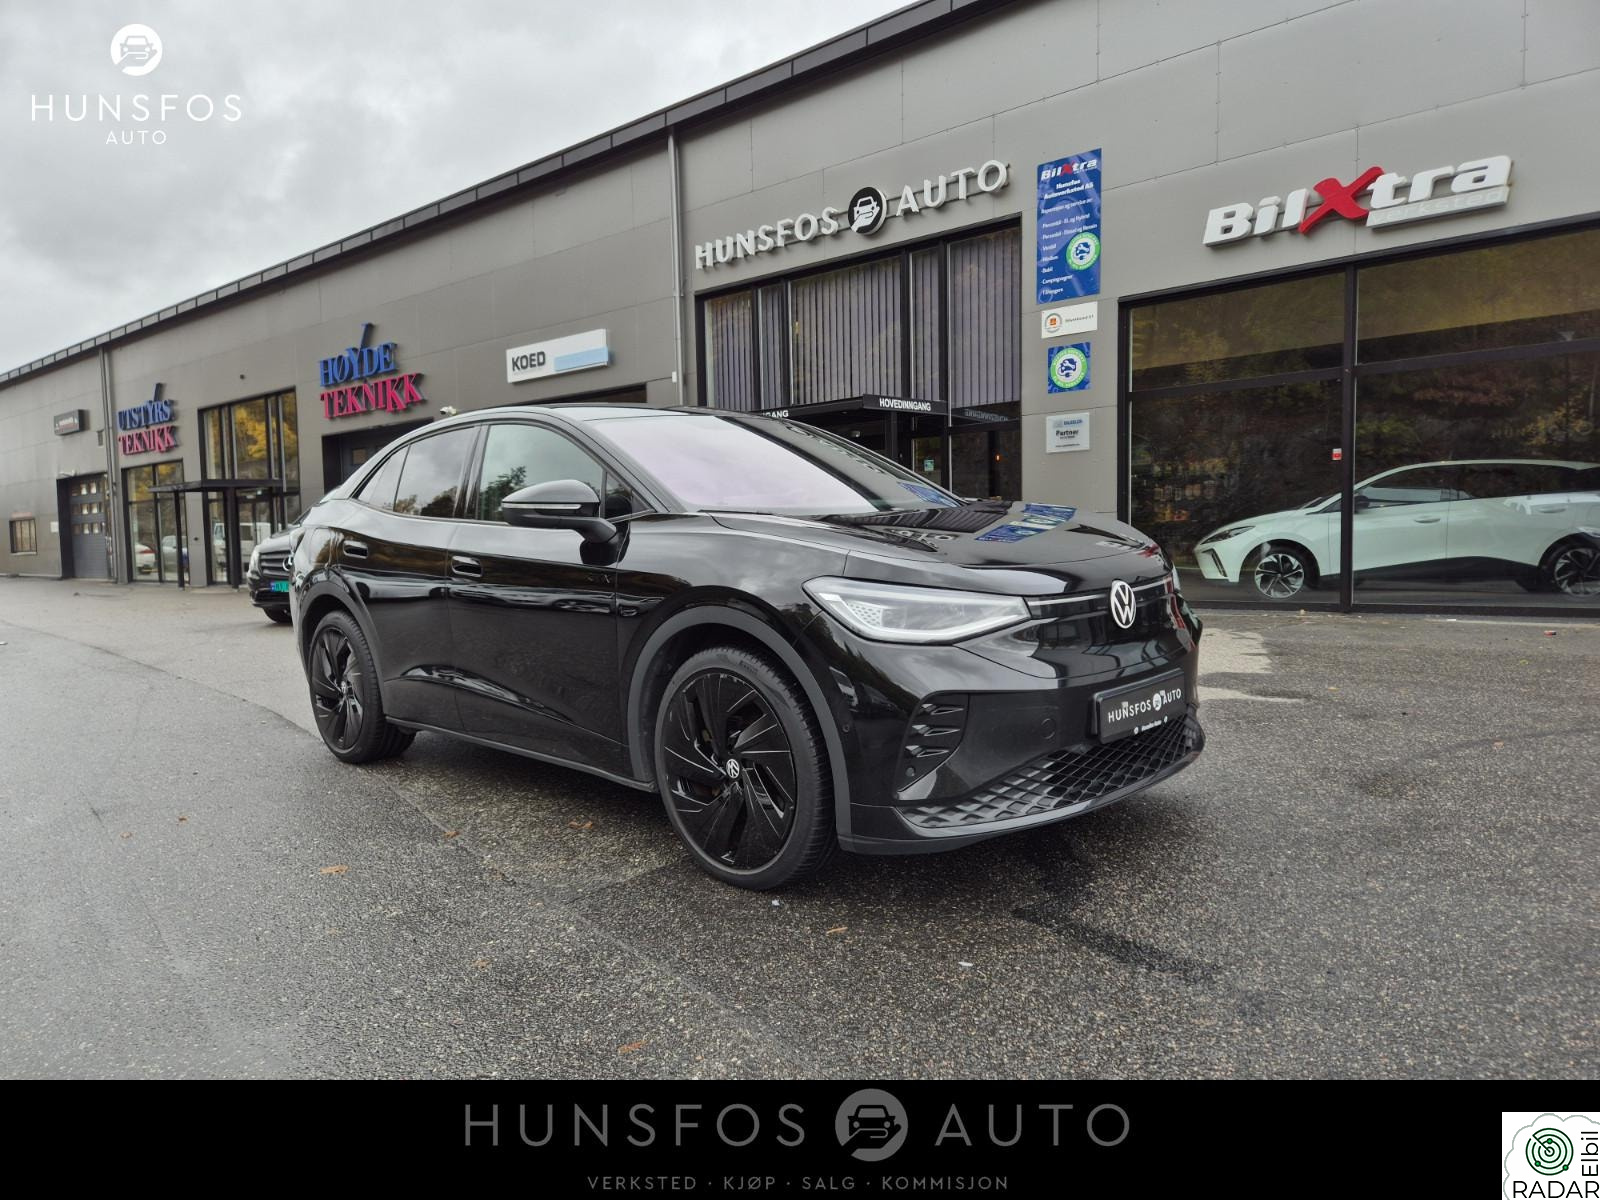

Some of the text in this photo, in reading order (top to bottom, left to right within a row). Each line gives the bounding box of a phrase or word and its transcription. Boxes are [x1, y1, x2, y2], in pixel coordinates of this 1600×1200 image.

[695, 159, 1008, 269] HUNSFOS AUTO
[512, 351, 546, 372] KOED
[117, 384, 173, 431] UTSTYRS
[320, 373, 424, 419] TEKNIKK
[879, 398, 931, 411] HOVEDINNGANG
[118, 424, 177, 455] TEKNIKK
[1056, 429, 1079, 437] Partner
[1111, 580, 1136, 629] VW
[1108, 688, 1182, 723] HUNSFOS AUTO
